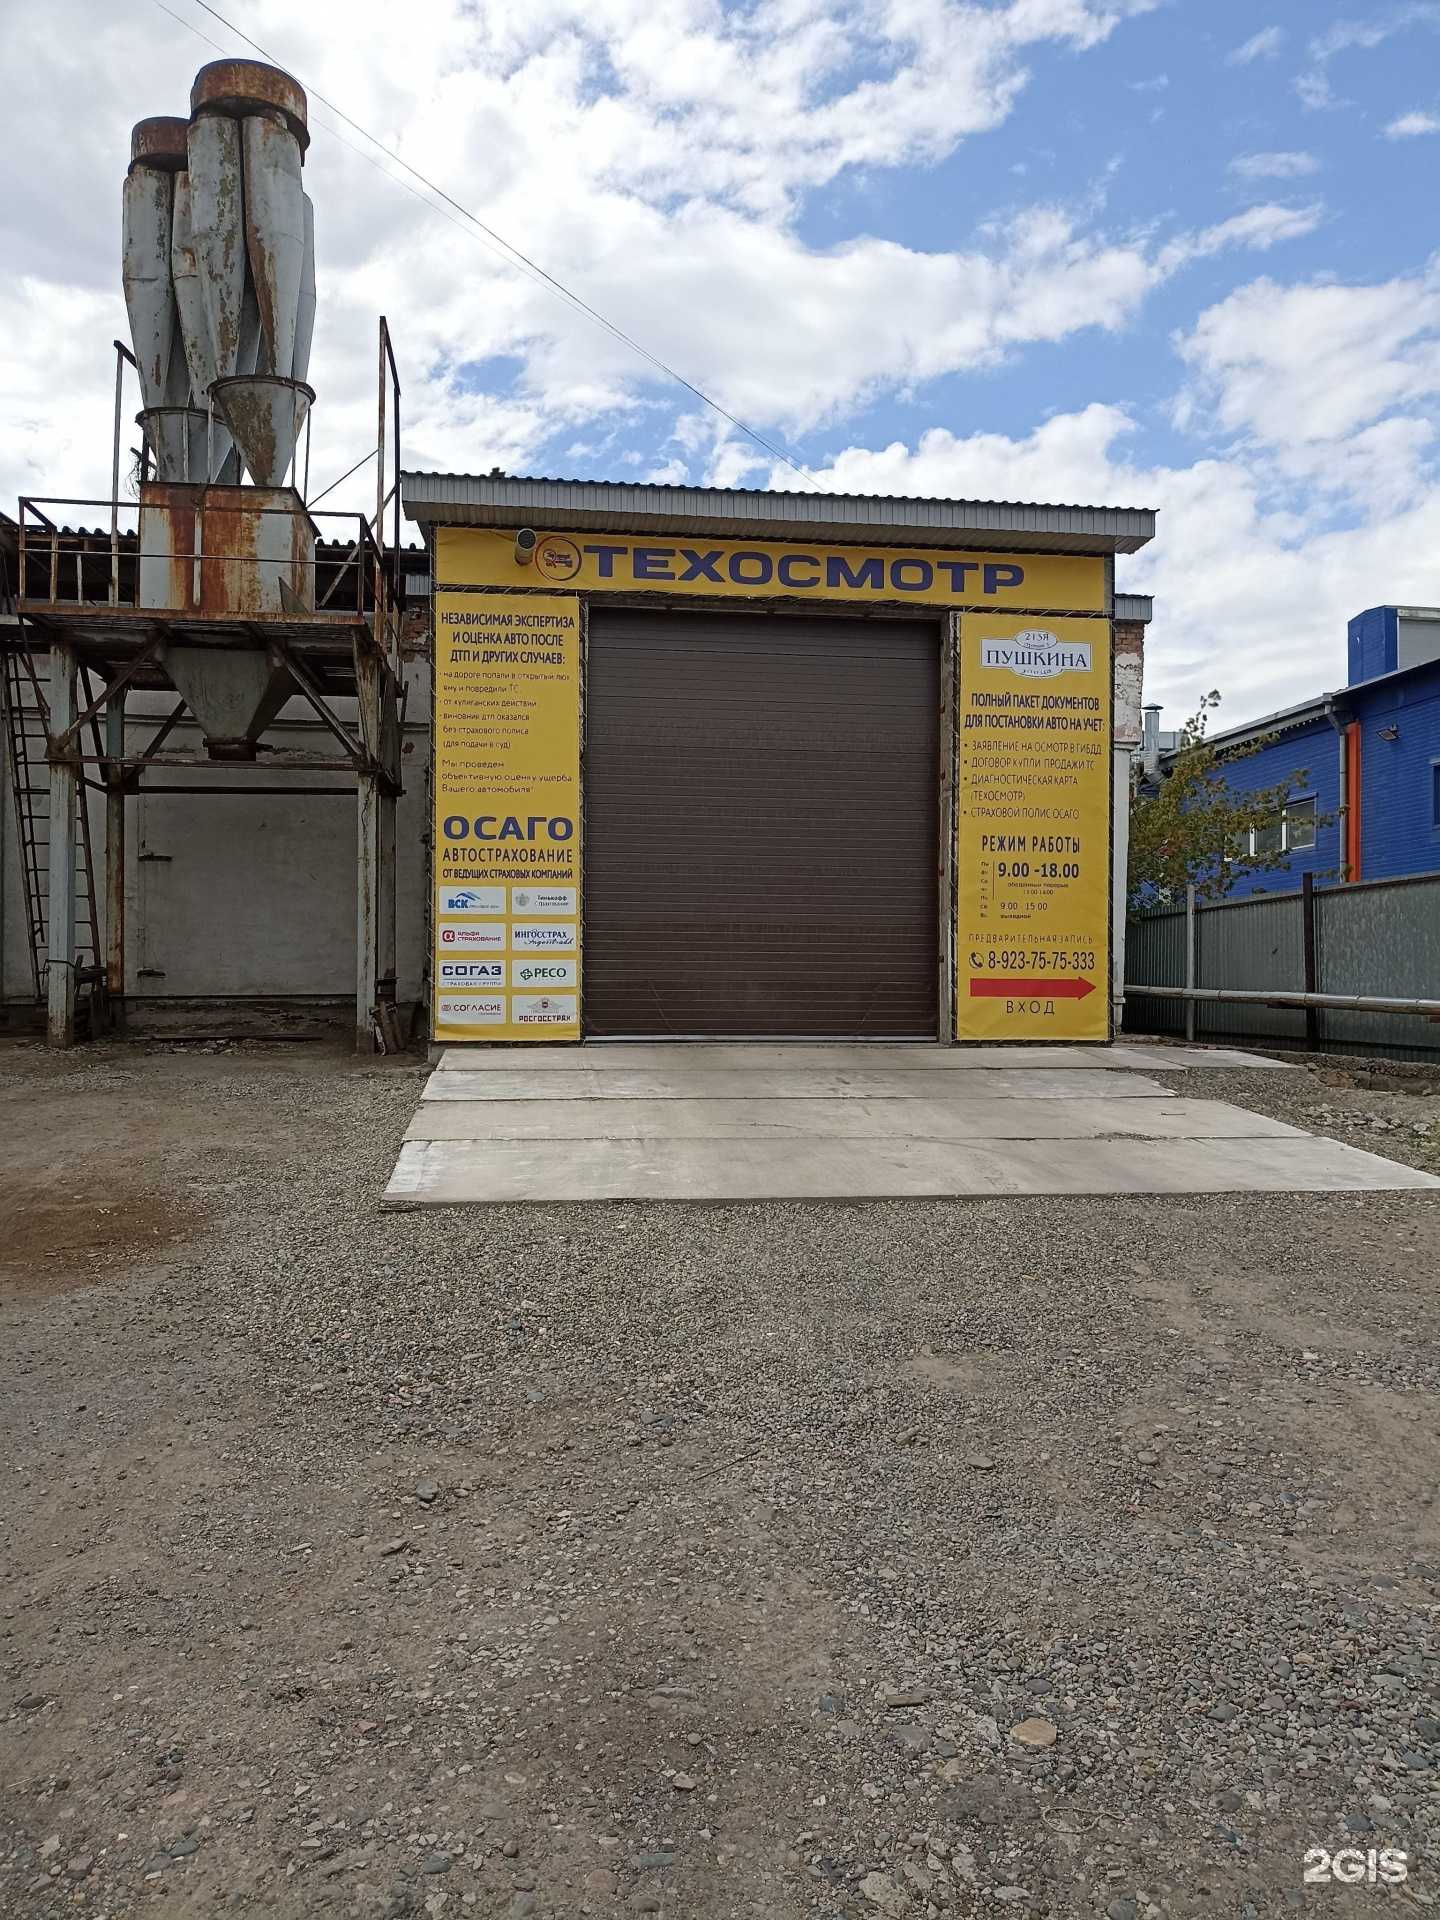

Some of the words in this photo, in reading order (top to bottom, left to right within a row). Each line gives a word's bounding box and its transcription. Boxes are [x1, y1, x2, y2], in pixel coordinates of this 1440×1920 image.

[583, 544, 1024, 594] ТЕХОСМОТР
[441, 613, 512, 626] НЕЗАВИСИМАЯ
[515, 615, 575, 628] ЭКСПЕРТИЗА
[453, 632, 460, 642] И
[462, 632, 502, 645] ОЦЕНКА
[504, 633, 530, 645] АВТО
[531, 634, 563, 646] ПОСЛЕ
[451, 650, 471, 662] ДТП
[472, 650, 480, 660] И
[482, 650, 519, 664] ДРУГИХ
[520, 652, 565, 664] СЛУЧАЕВ:
[986, 650, 1088, 668] ПУШКИНА
[454, 672, 481, 680] дороге
[466, 685, 507, 693] повредили
[971, 692, 1011, 707] ПОЛНЫЙ
[1012, 694, 1041, 709] ПАКЕТ
[1041, 695, 1100, 711] ДОКУМЕНТОВ
[964, 714, 982, 729] ДЛЯ
[984, 715, 1044, 729] ПОСТАНОВКИ
[1045, 717, 1068, 730] АВТО
[1069, 719, 1082, 730] НА
[1083, 719, 1105, 732] УЧЕТ:
[971, 740, 1020, 751] ЗАЯВЛЕНИЕ
[1021, 742, 1033, 751] НА
[1034, 742, 1069, 752] ОСМОТР
[1077, 743, 1102, 755] ГИБДД
[971, 757, 1012, 768] ДОГОВОР
[441, 773, 502, 781] объективную
[539, 774, 572, 783] ущерба
[971, 774, 1054, 785] ДИАГНОСТИЧЕСКАЯ
[1054, 776, 1078, 785] КАРТА
[441, 784, 475, 792] Вашего
[970, 807, 1020, 818] СТРАХОВОЙ
[1021, 808, 1052, 818] ПОЛИС
[1053, 809, 1080, 819] ОСАГО
[443, 815, 573, 841] ОСАГО
[982, 835, 1027, 852] РЕЖИМ
[1032, 836, 1080, 853] РАБОТЫ
[442, 848, 573, 863] АВТОСТРАХОВАНИЕ
[442, 869, 452, 878] ОТ
[453, 869, 489, 879] ВЕДУЩИХ
[489, 869, 530, 879] СТРАХОВЫХ
[531, 869, 573, 879] КОМПАНИЙ
[998, 862, 1030, 878] 9.00
[447, 899, 469, 909] ВСК
[514, 930, 568, 939] ИНГОССТРАХ
[969, 933, 1057, 944] ПРЕДВАРИТЕЛЬНАЯ
[1058, 935, 1094, 944] ЗАПИСЬ
[988, 951, 1095, 970] 8-923-75-75-333
[442, 965, 502, 976] СОГАЗ
[534, 967, 567, 978] РЕСО
[453, 1004, 501, 1012] СОГЛАСИЕ
[1006, 1001, 1055, 1014] ВХОД
[518, 1014, 572, 1023] РОСГОССТРАХ
